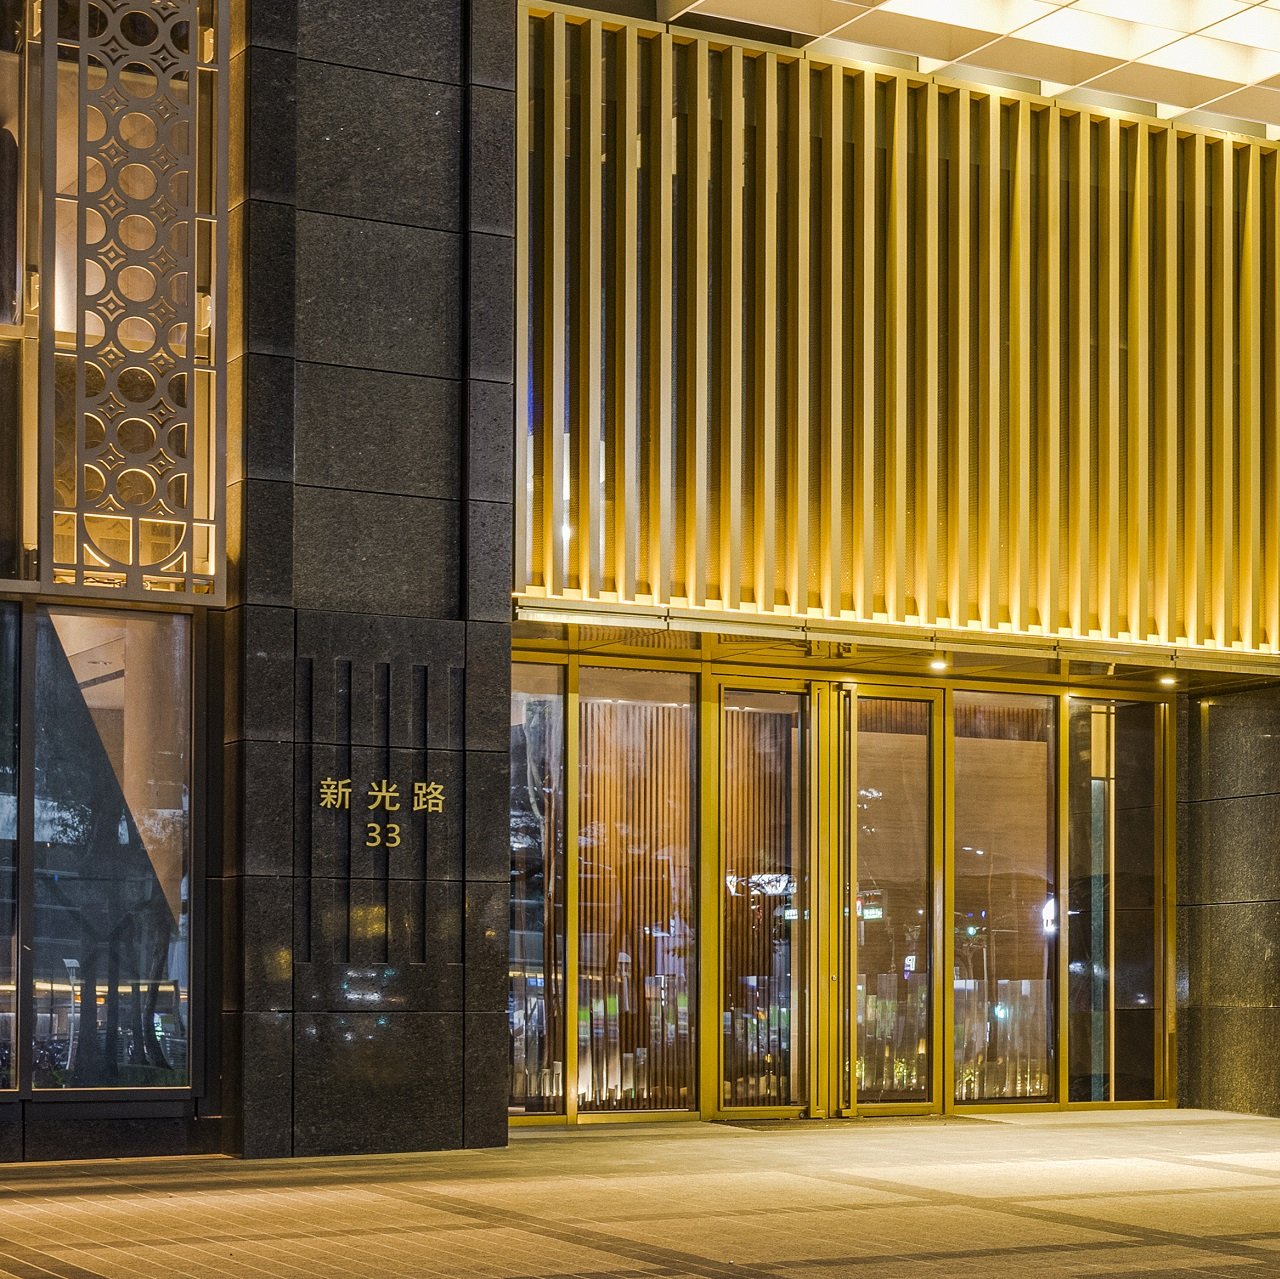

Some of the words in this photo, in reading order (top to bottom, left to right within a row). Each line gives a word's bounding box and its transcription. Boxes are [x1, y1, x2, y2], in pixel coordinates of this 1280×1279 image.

[319, 777, 446, 813] 新光路
[365, 822, 401, 848] 33
